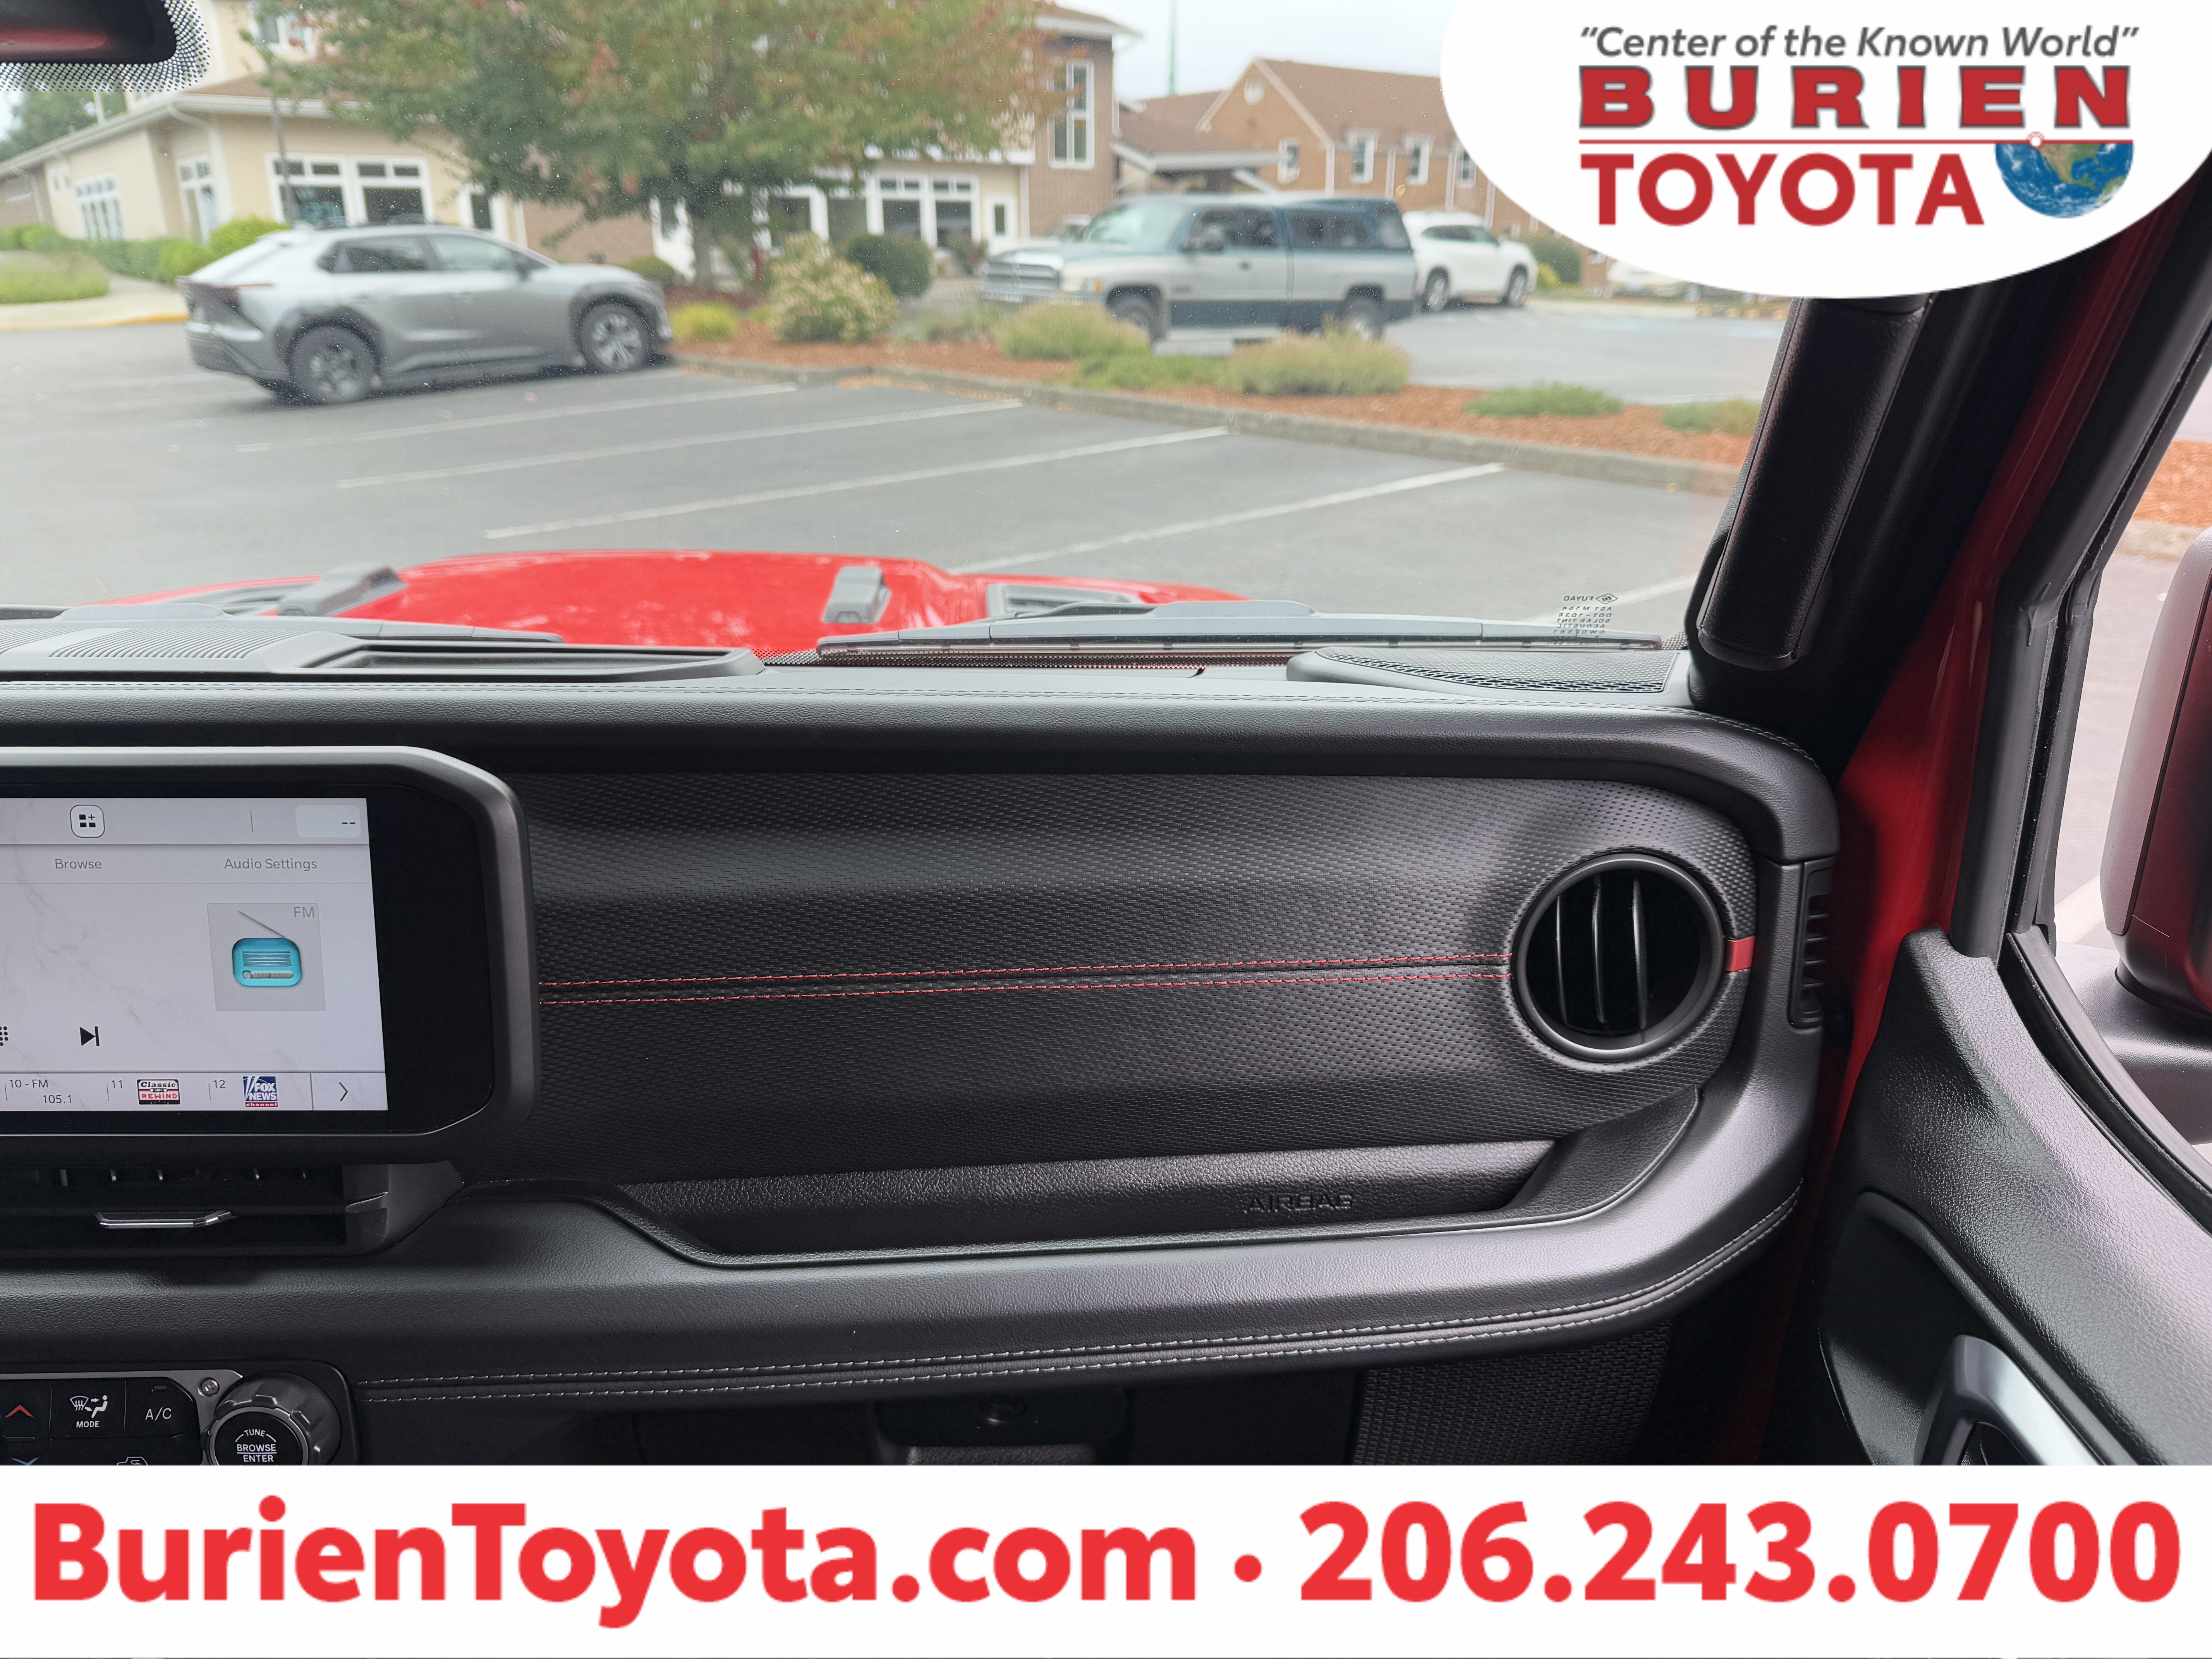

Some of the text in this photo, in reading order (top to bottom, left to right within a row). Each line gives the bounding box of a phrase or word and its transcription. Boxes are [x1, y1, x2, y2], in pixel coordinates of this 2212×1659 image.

[55, 858, 102, 869] Browse
[224, 858, 317, 871] Audio Settings
[294, 907, 315, 918] FM
[10, 1079, 22, 1088] 10
[32, 1079, 48, 1088] FM
[112, 1080, 122, 1089] 11
[213, 1080, 226, 1088] 12
[254, 1083, 276, 1092] FOX
[43, 1095, 71, 1104] 105.1
[249, 1092, 277, 1101] NEWS
[1243, 1194, 1353, 1213] AIRBAG
[145, 1407, 172, 1421] A/C
[244, 1429, 266, 1437] TUNE
